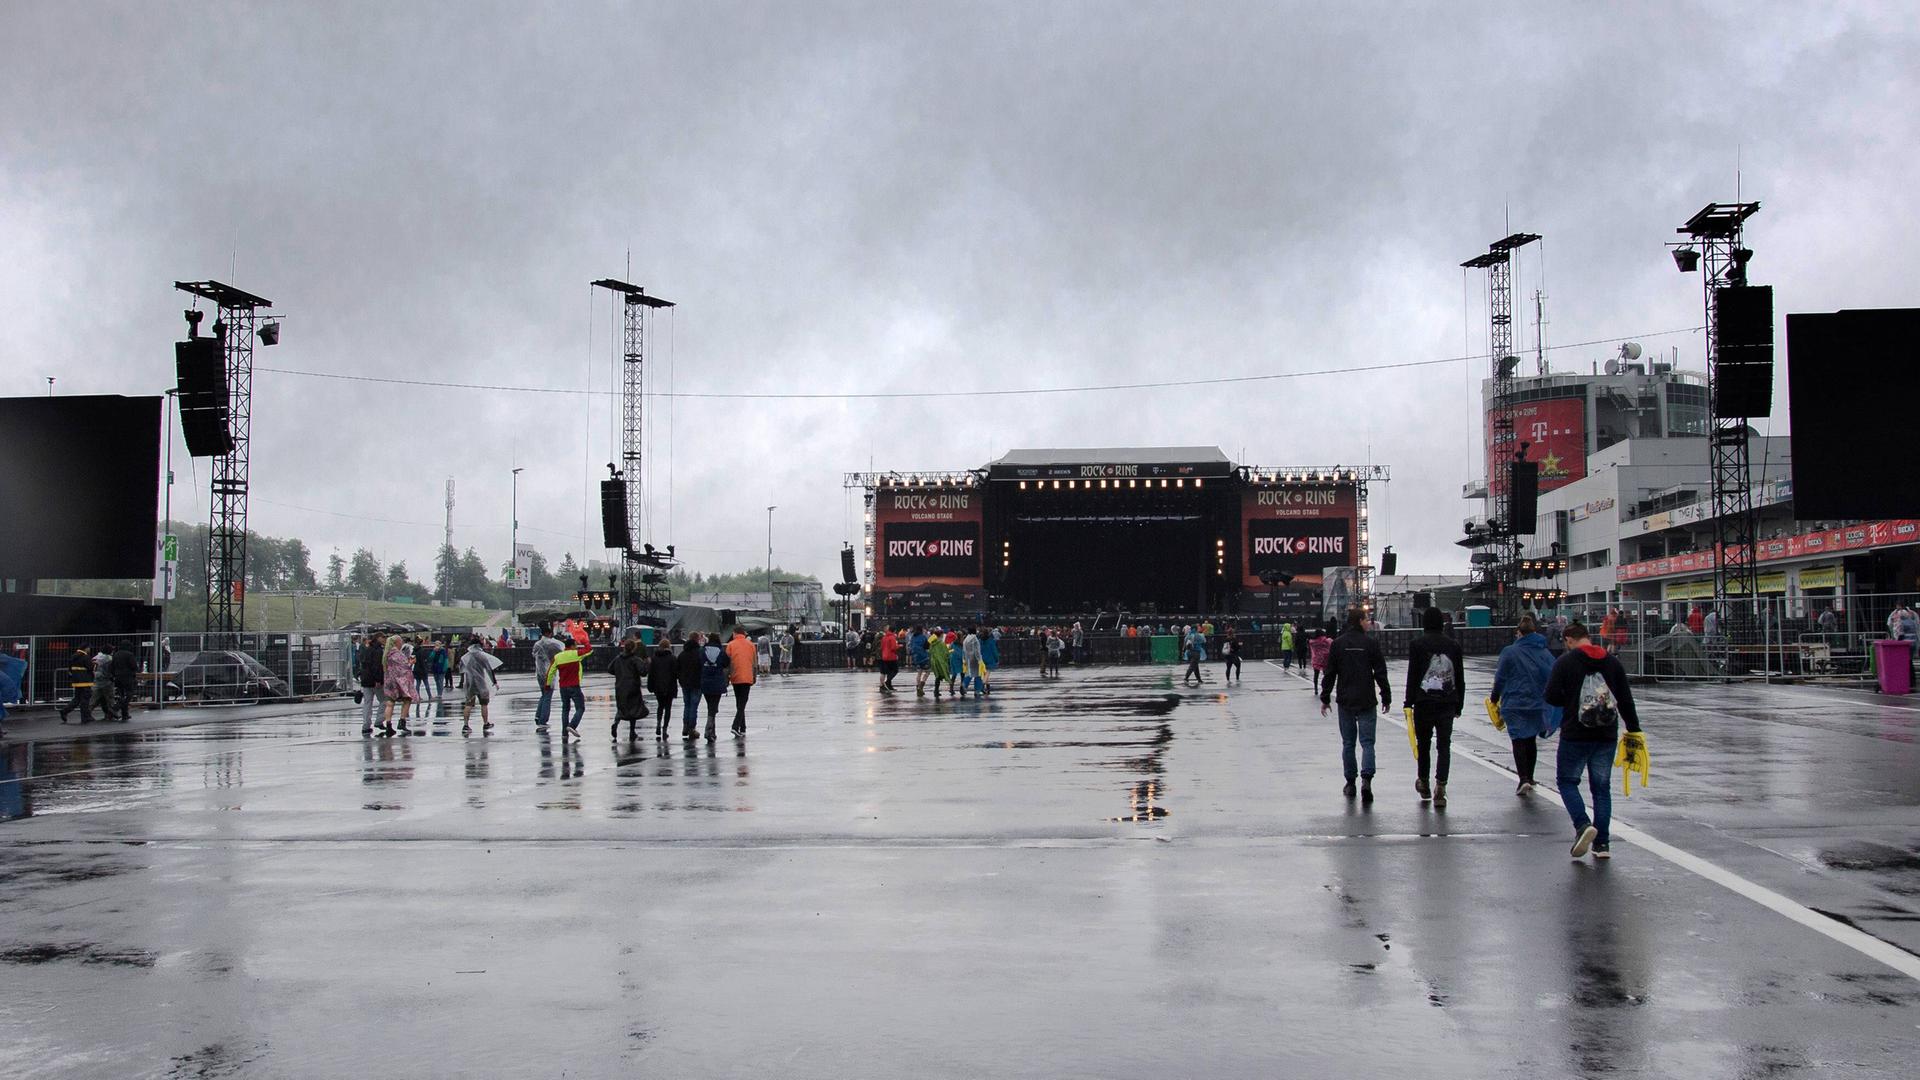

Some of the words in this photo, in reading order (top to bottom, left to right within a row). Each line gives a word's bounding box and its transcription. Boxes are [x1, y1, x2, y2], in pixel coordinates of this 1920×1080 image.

[1080, 465, 1106, 477] ROCK
[1115, 464, 1138, 477] RING
[894, 495, 927, 509] ROCK
[940, 494, 969, 509] RING
[1258, 490, 1292, 505] ROCK
[1305, 490, 1336, 505] RING
[889, 540, 926, 557] ROCK
[940, 539, 974, 557] RING
[1255, 537, 1294, 554] ROCK
[1308, 536, 1344, 554] RING
[517, 550, 533, 558] WC
